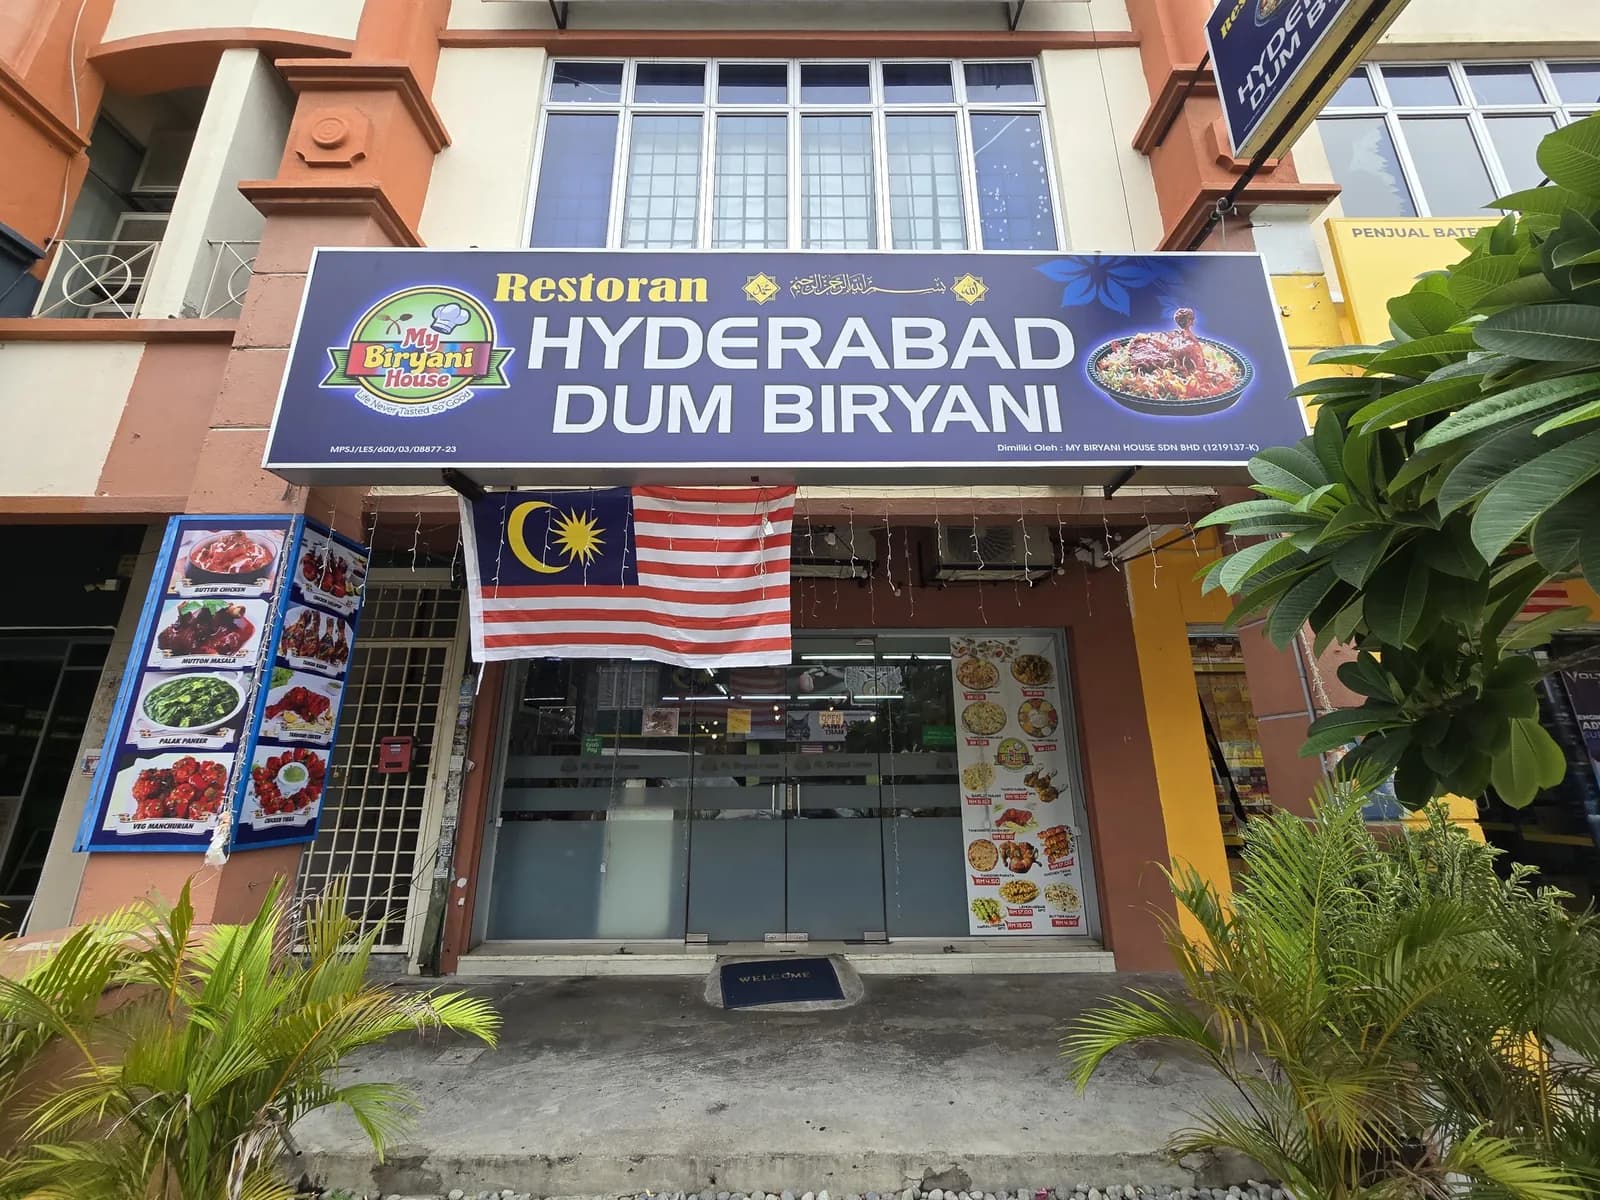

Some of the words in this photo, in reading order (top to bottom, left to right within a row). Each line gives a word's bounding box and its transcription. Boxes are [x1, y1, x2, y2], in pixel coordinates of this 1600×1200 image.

[1238, 0, 1310, 104] HYDE
[1250, 31, 1300, 111] DUM
[1352, 228, 1430, 238] PENJUAL
[1433, 228, 1480, 238] BATE
[494, 272, 708, 303] Restoran
[403, 328, 440, 351] My
[528, 316, 1075, 370] HYDERABAD
[364, 345, 474, 374] Biryani
[385, 369, 450, 387] House
[356, 390, 371, 404] Life
[371, 400, 396, 414] Never
[400, 407, 430, 416] Tasted
[432, 404, 445, 412] So
[446, 390, 471, 407] Good
[552, 385, 732, 434] DUM
[763, 385, 1063, 434] BIRYANI
[997, 443, 1032, 452] Dimiliki
[1034, 443, 1058, 452] Oleh
[1066, 443, 1081, 452] MY
[1083, 443, 1121, 452] BIRYANI
[1123, 443, 1156, 452] HOUSE
[1158, 443, 1178, 452] SDN
[1181, 443, 1201, 452] BHD
[1202, 443, 1260, 453] (1219137-K)
[1583, 721, 1600, 730] AD
[739, 972, 811, 983] WELCOME
